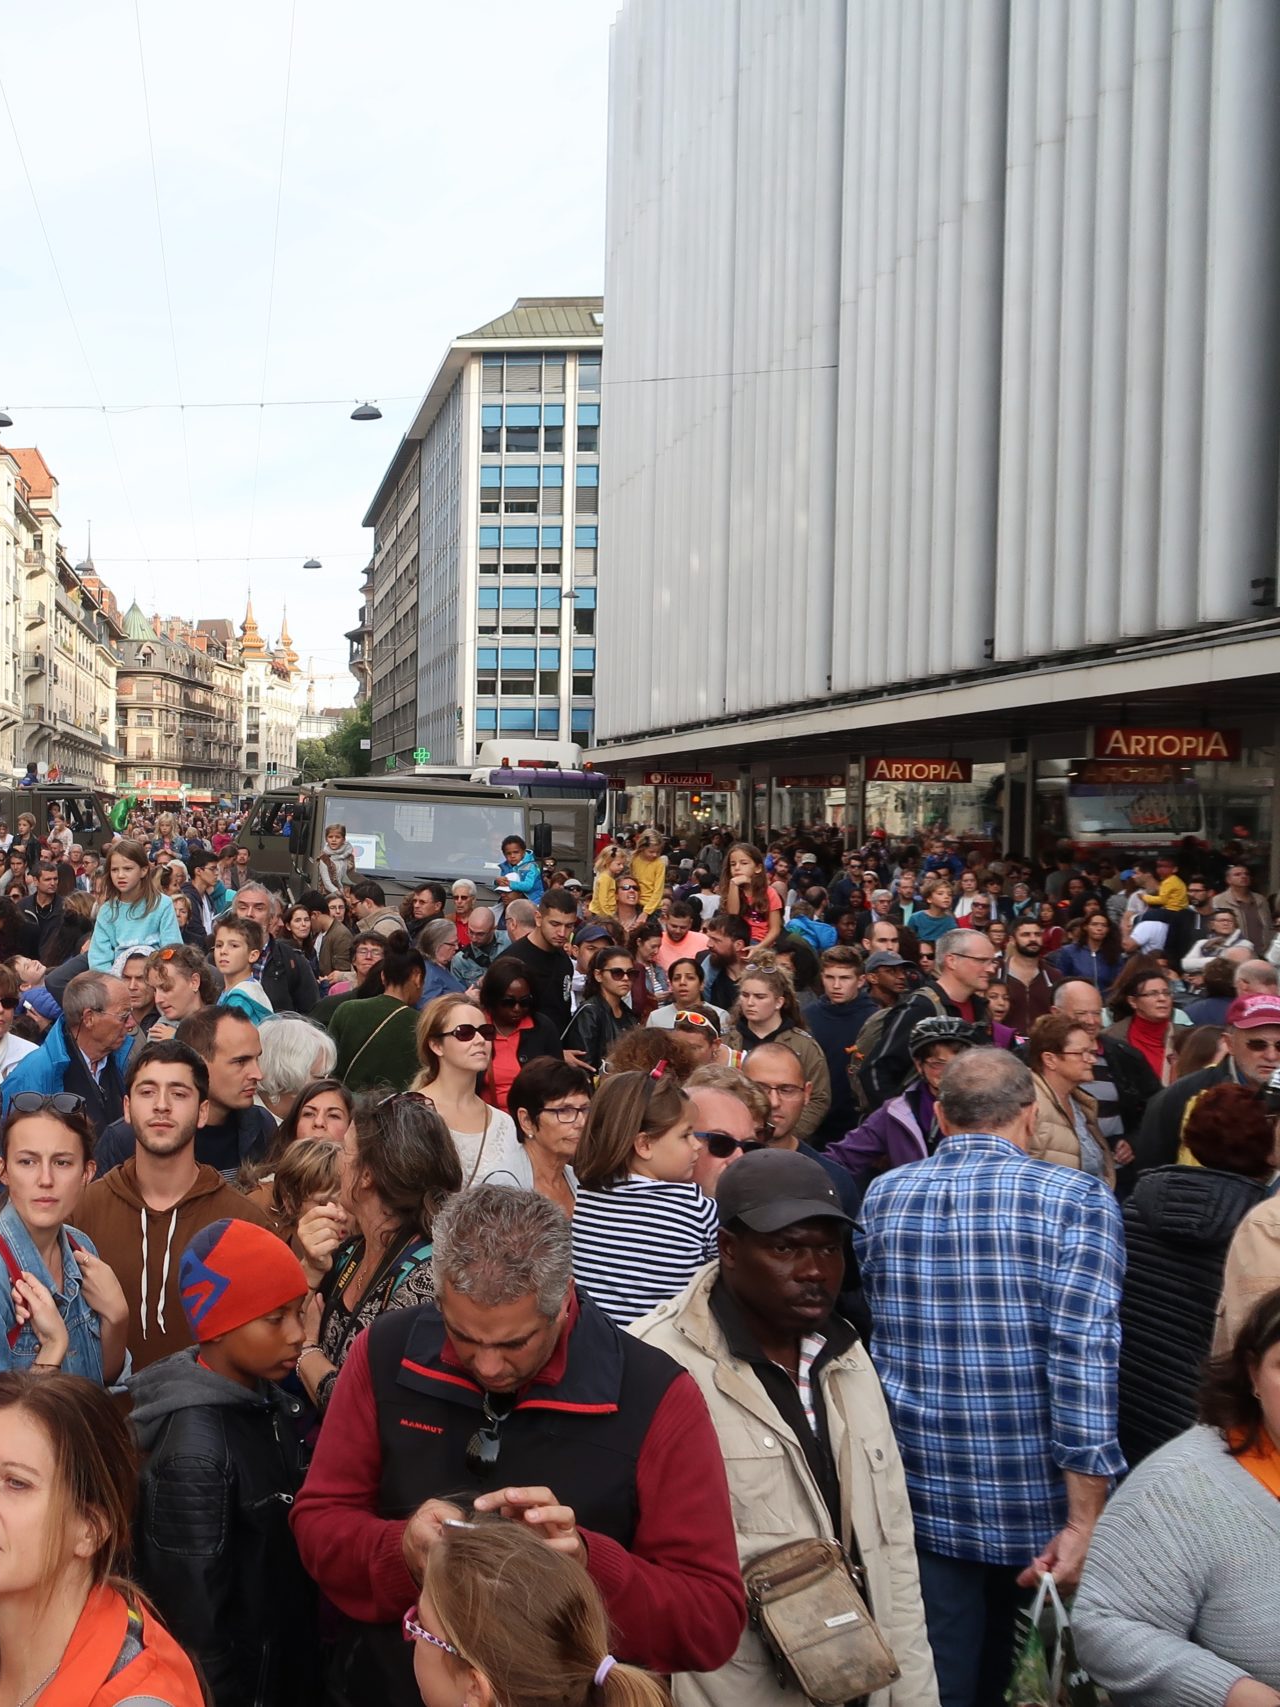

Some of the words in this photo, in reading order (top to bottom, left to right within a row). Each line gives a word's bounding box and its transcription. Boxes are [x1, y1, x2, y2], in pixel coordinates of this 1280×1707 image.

[1104, 729, 1229, 757] ARTOPIA
[873, 759, 964, 780] ARTOPIA
[337, 1260, 357, 1289] Nikon
[400, 1418, 444, 1434] MAMMUT
